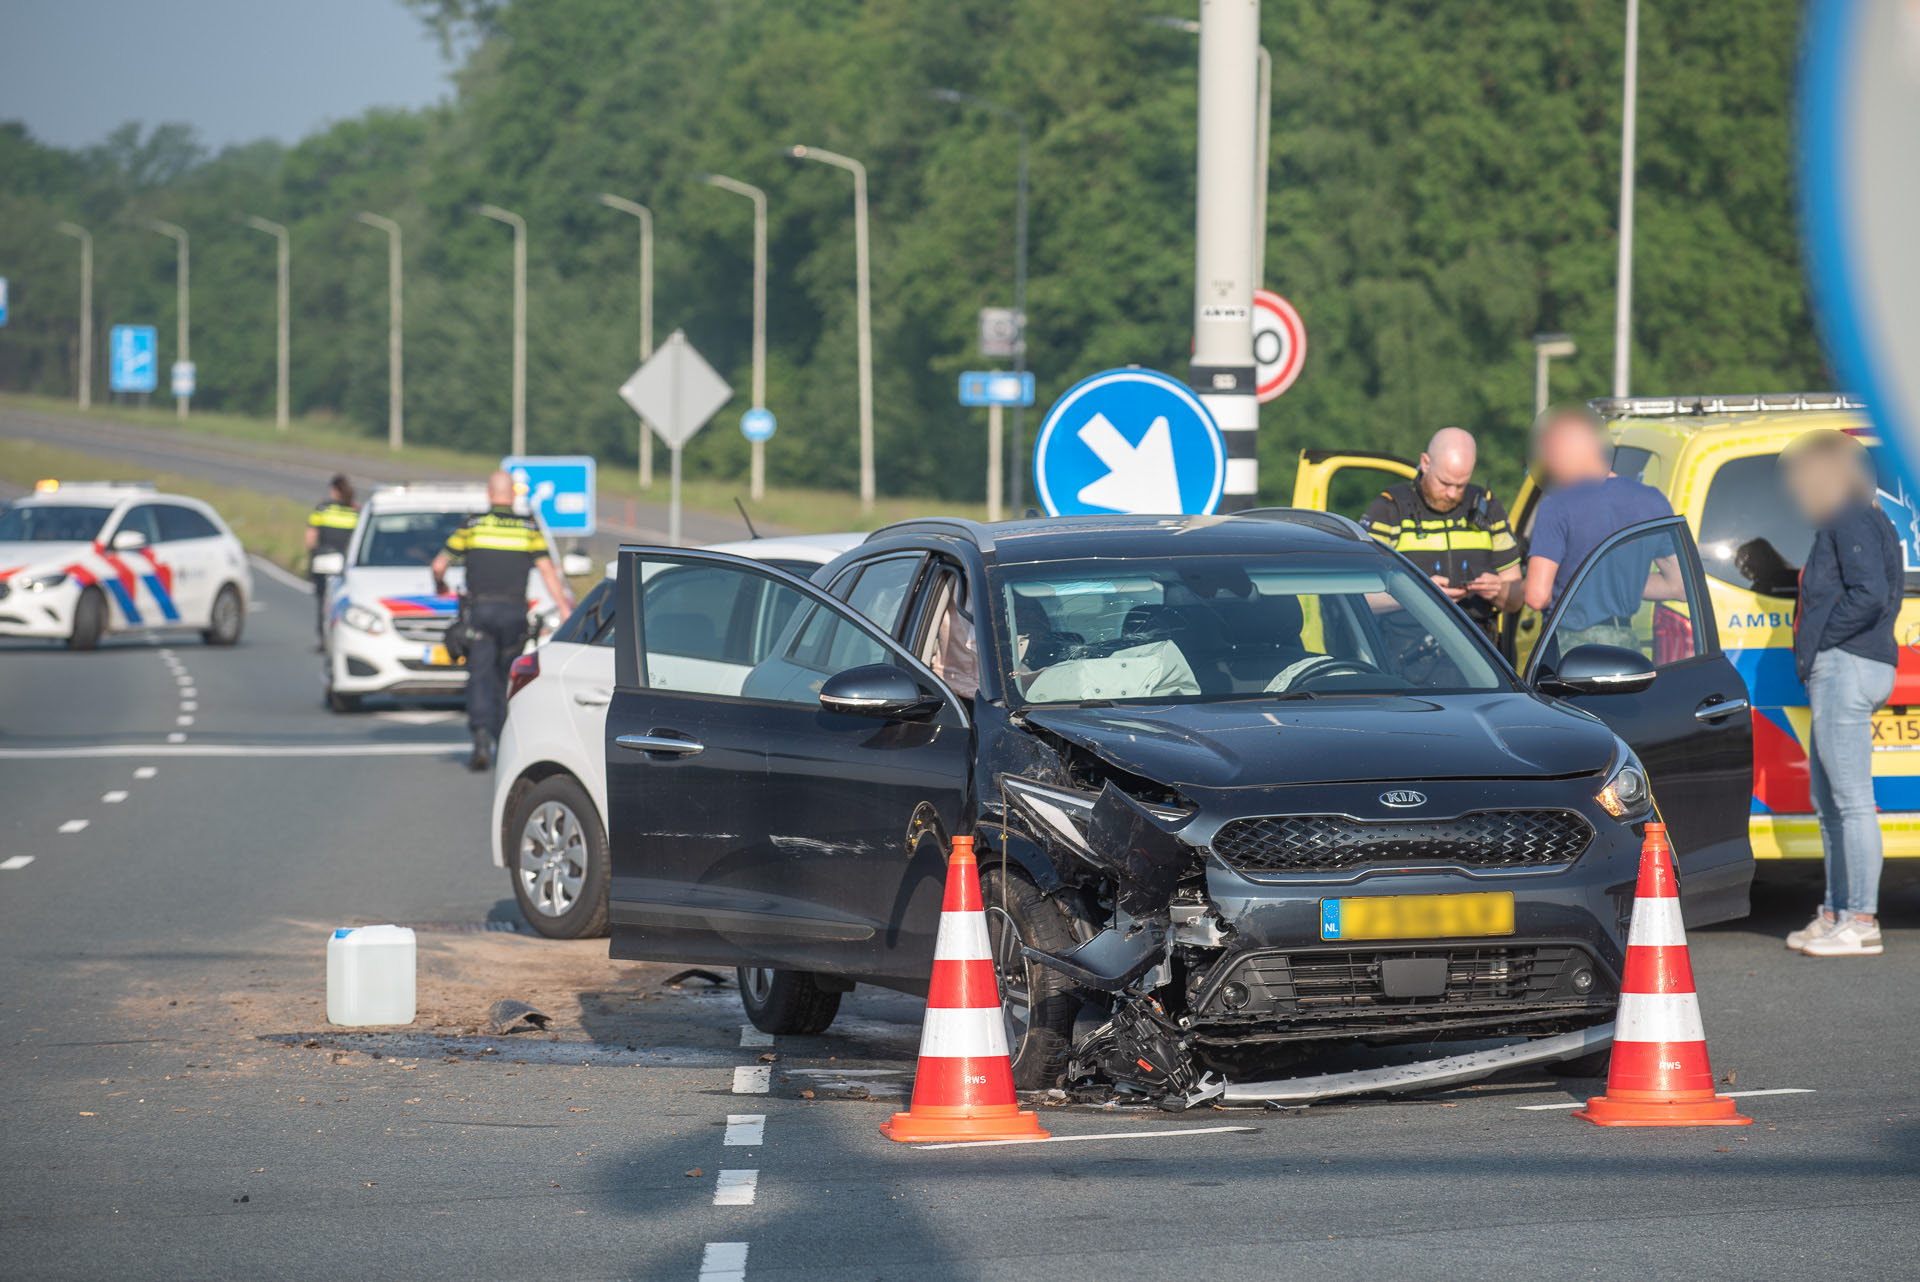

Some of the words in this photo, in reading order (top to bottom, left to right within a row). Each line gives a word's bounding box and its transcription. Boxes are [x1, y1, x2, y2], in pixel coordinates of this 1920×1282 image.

[1386, 792, 1421, 802] KIA
[1325, 923, 1338, 932] NL
[1659, 1061, 1681, 1070] RWS
